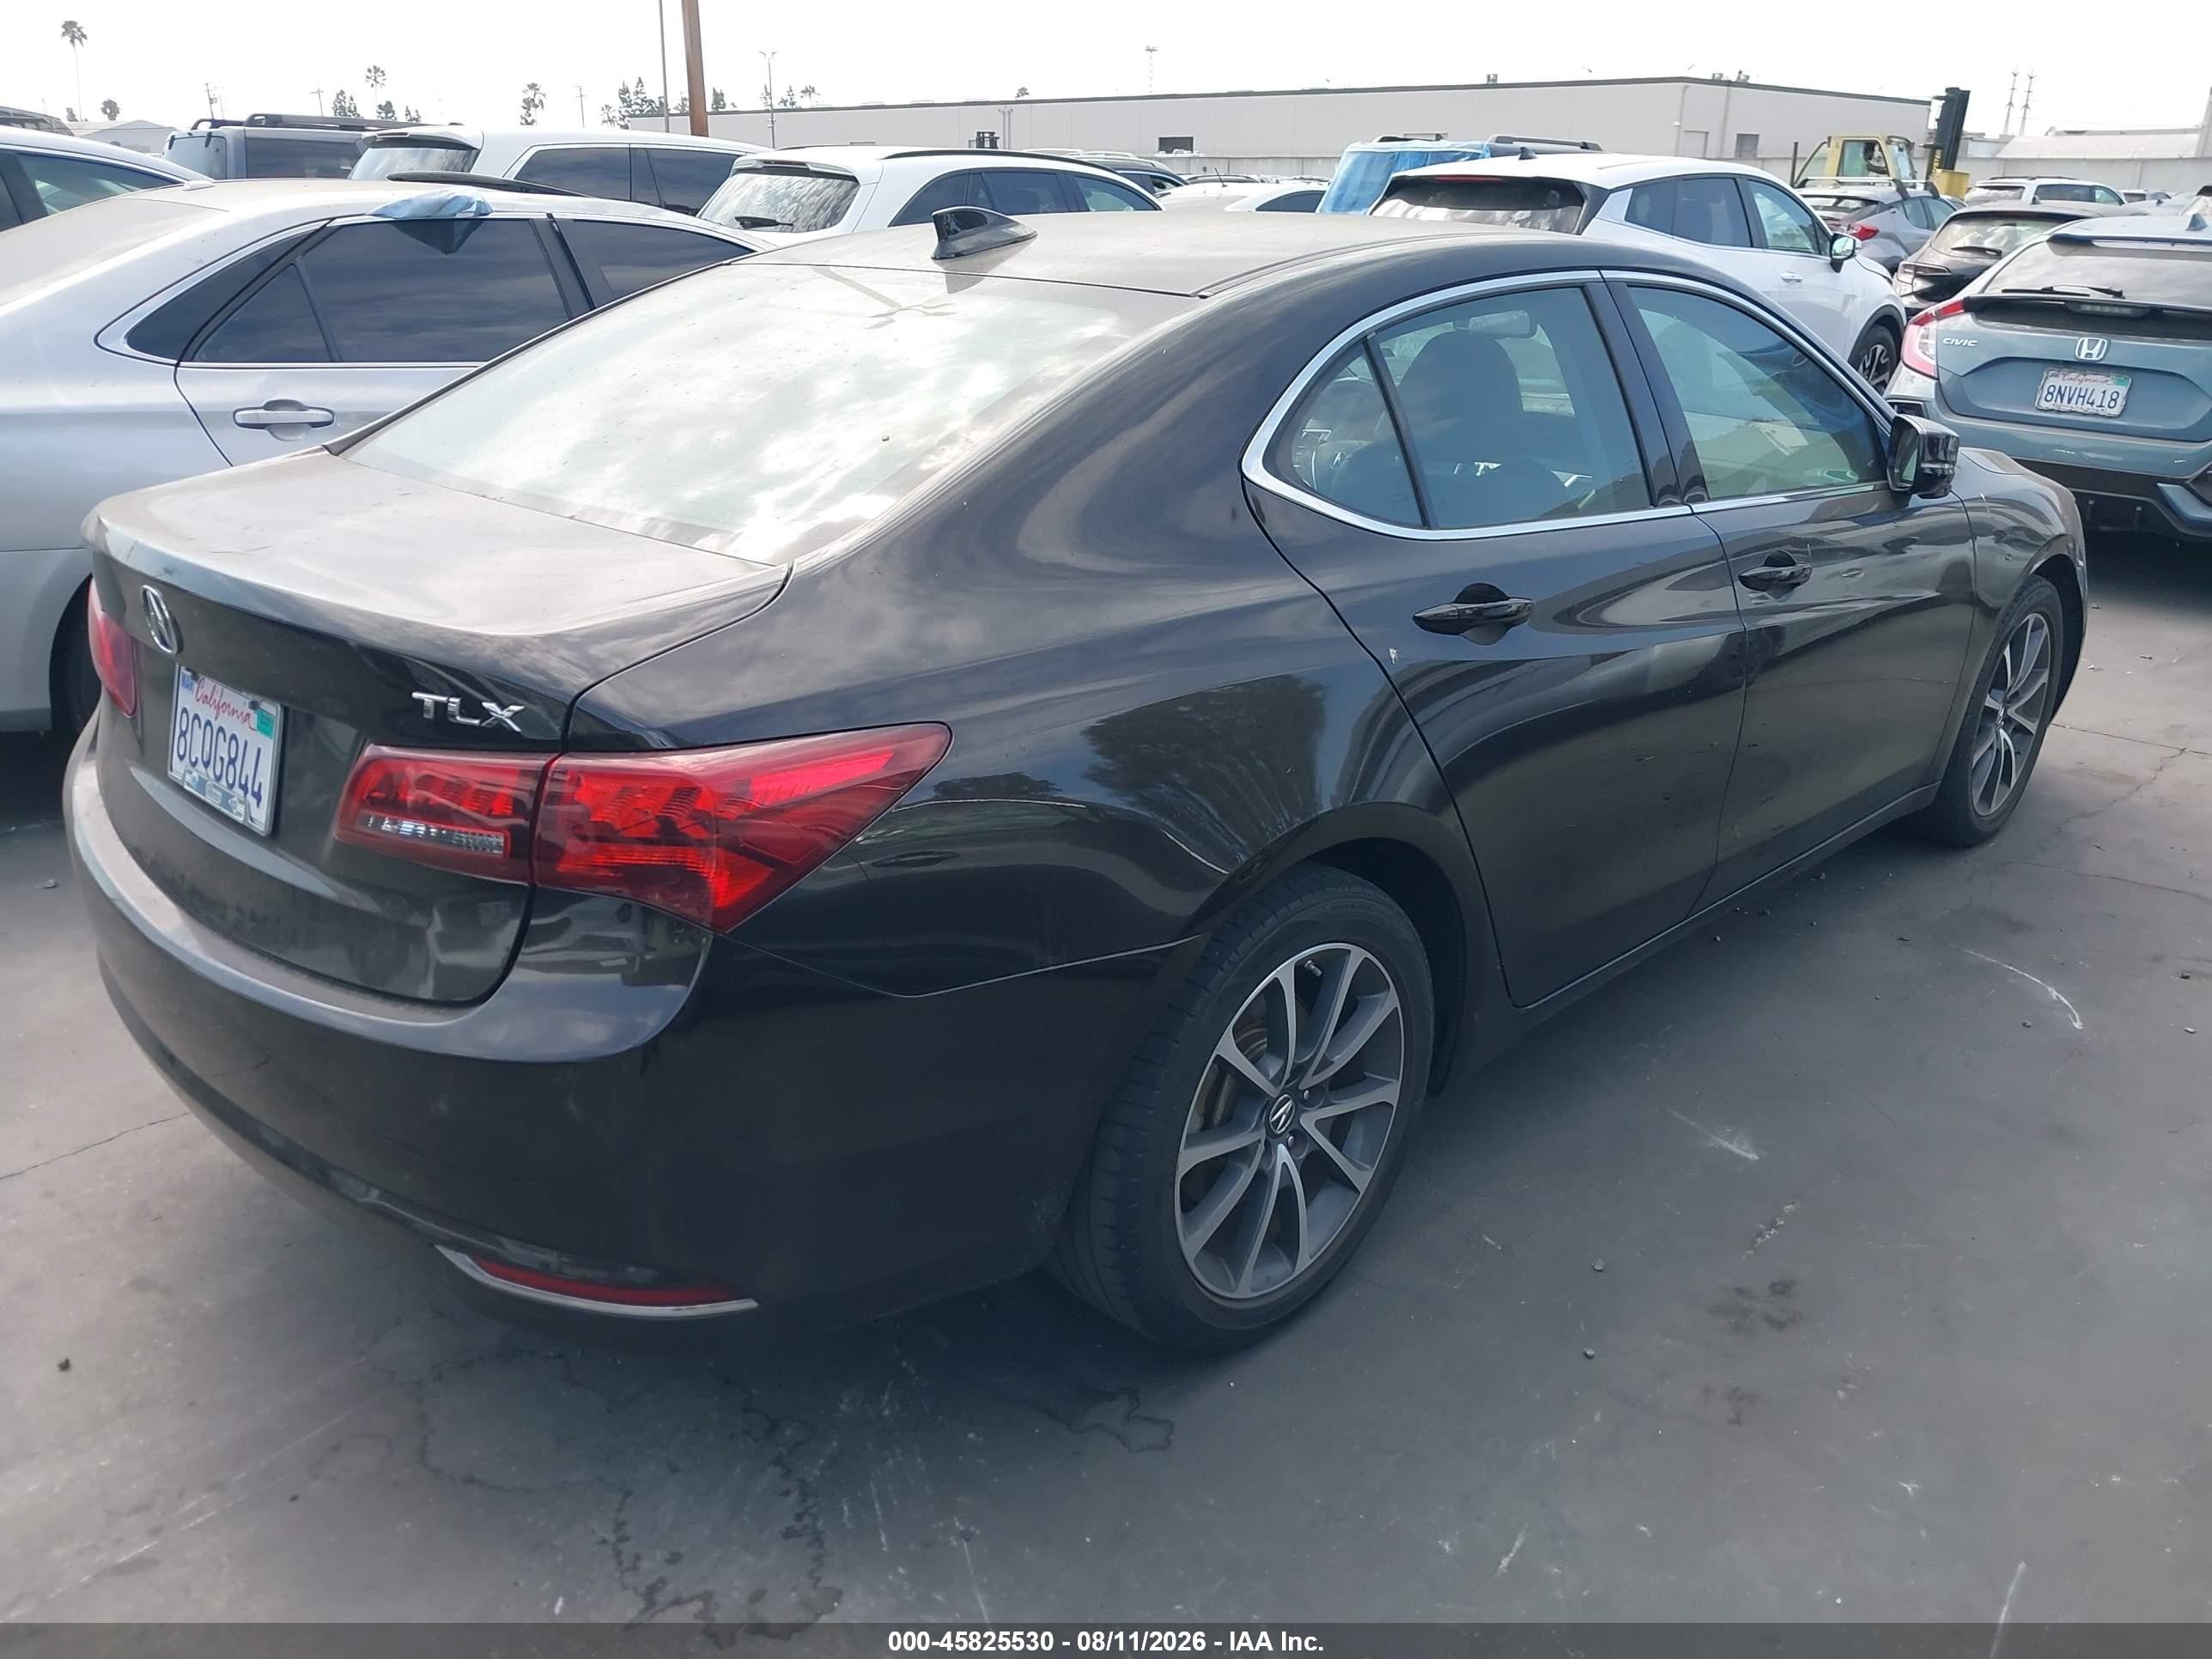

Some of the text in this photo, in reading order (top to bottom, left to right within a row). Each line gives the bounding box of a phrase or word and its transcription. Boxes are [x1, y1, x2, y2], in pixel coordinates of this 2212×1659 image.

[1942, 337, 1978, 347] CIVIC
[2062, 372, 2111, 386] California
[2044, 384, 2120, 410] 8NVH418
[194, 677, 257, 732] California
[411, 691, 526, 732] TLX
[177, 707, 262, 809] 8CQG844
